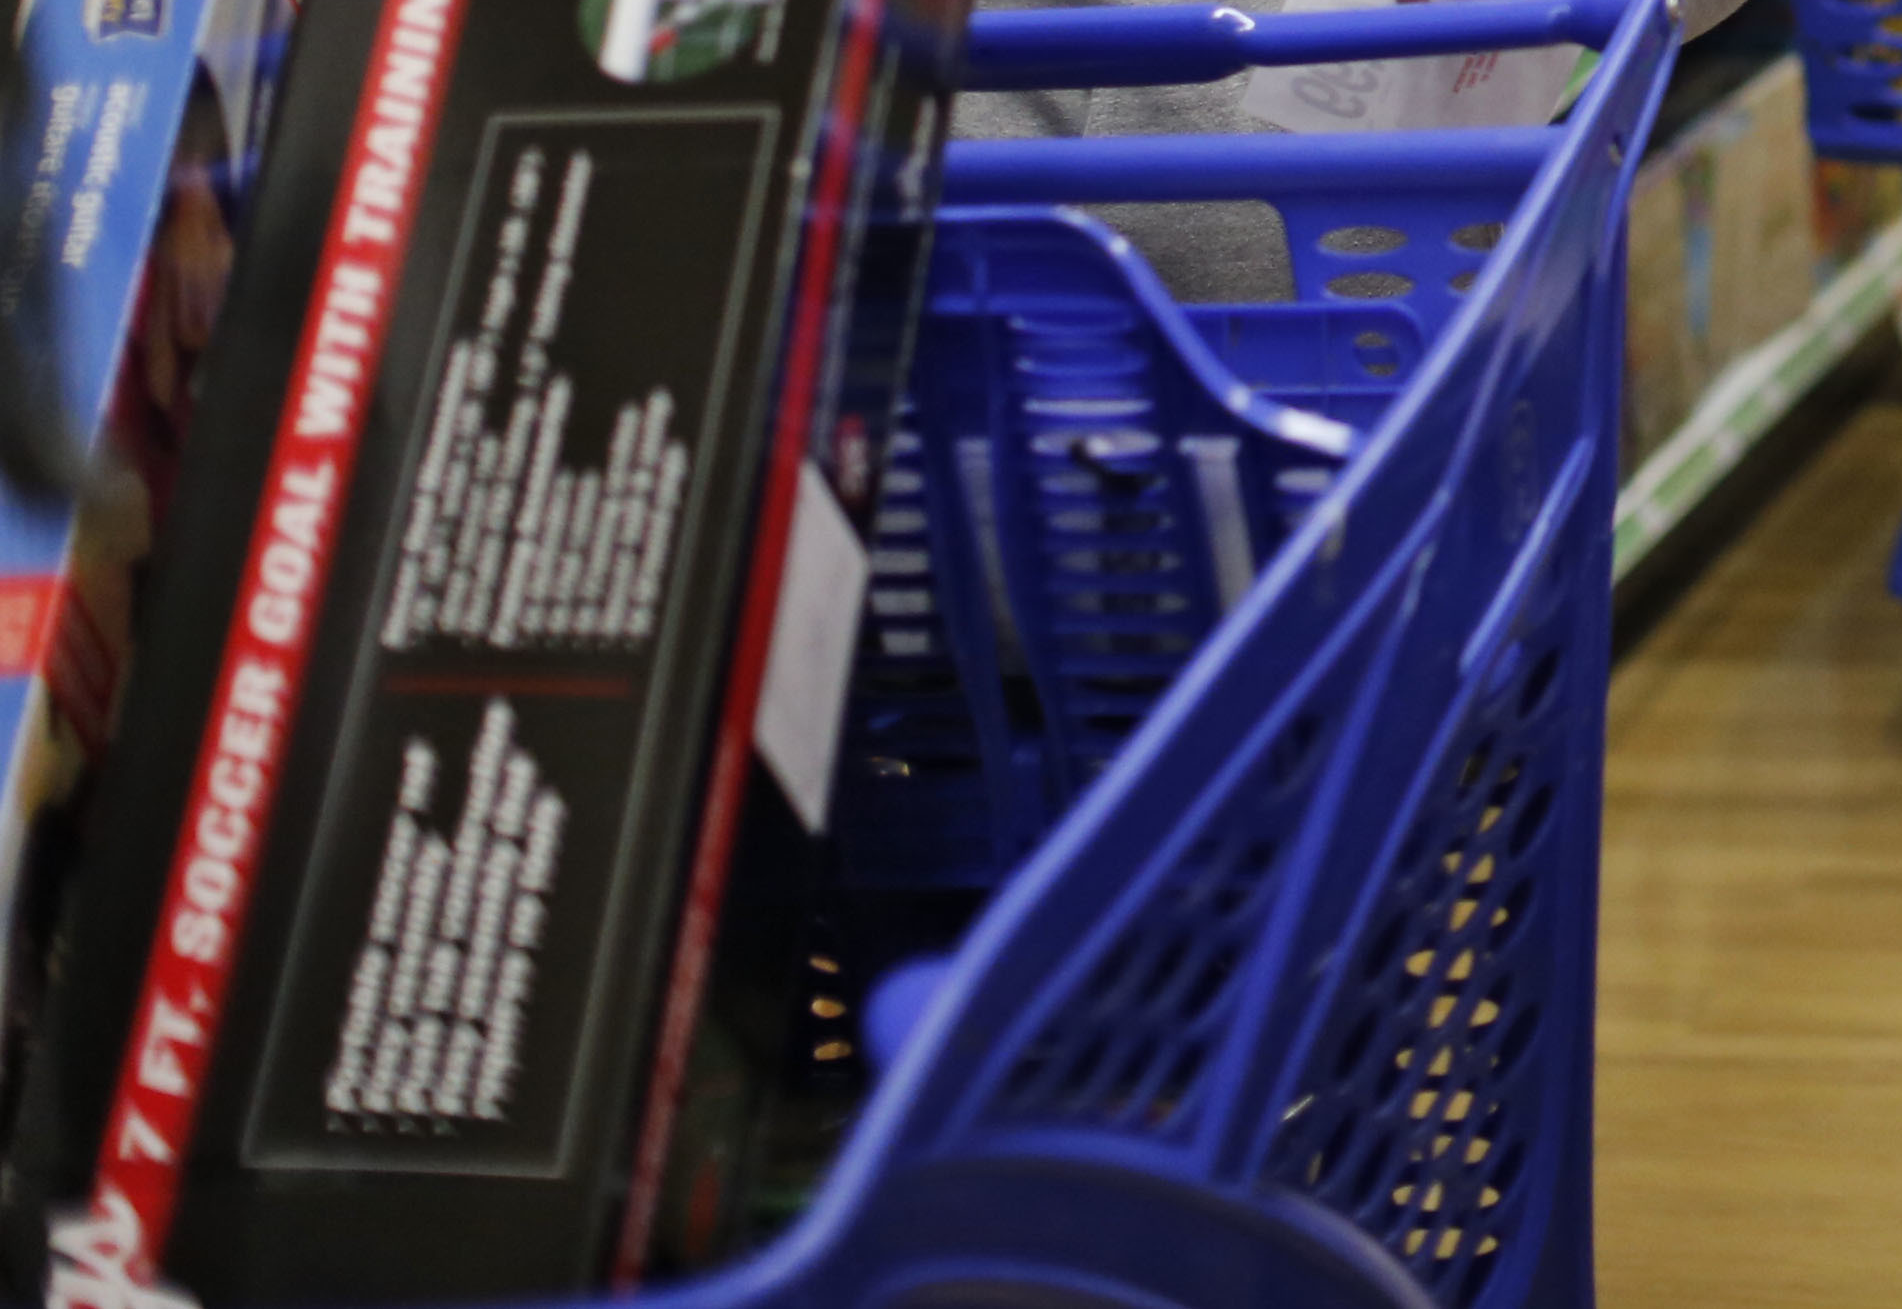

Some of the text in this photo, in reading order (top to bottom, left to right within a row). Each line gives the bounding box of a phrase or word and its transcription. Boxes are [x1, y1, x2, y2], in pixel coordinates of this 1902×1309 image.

[294, 264, 383, 437] WITH
[249, 458, 338, 645] GOAL
[171, 660, 289, 963] SOCCER
[138, 983, 212, 1098] FT.
[118, 1109, 177, 1167] 7
